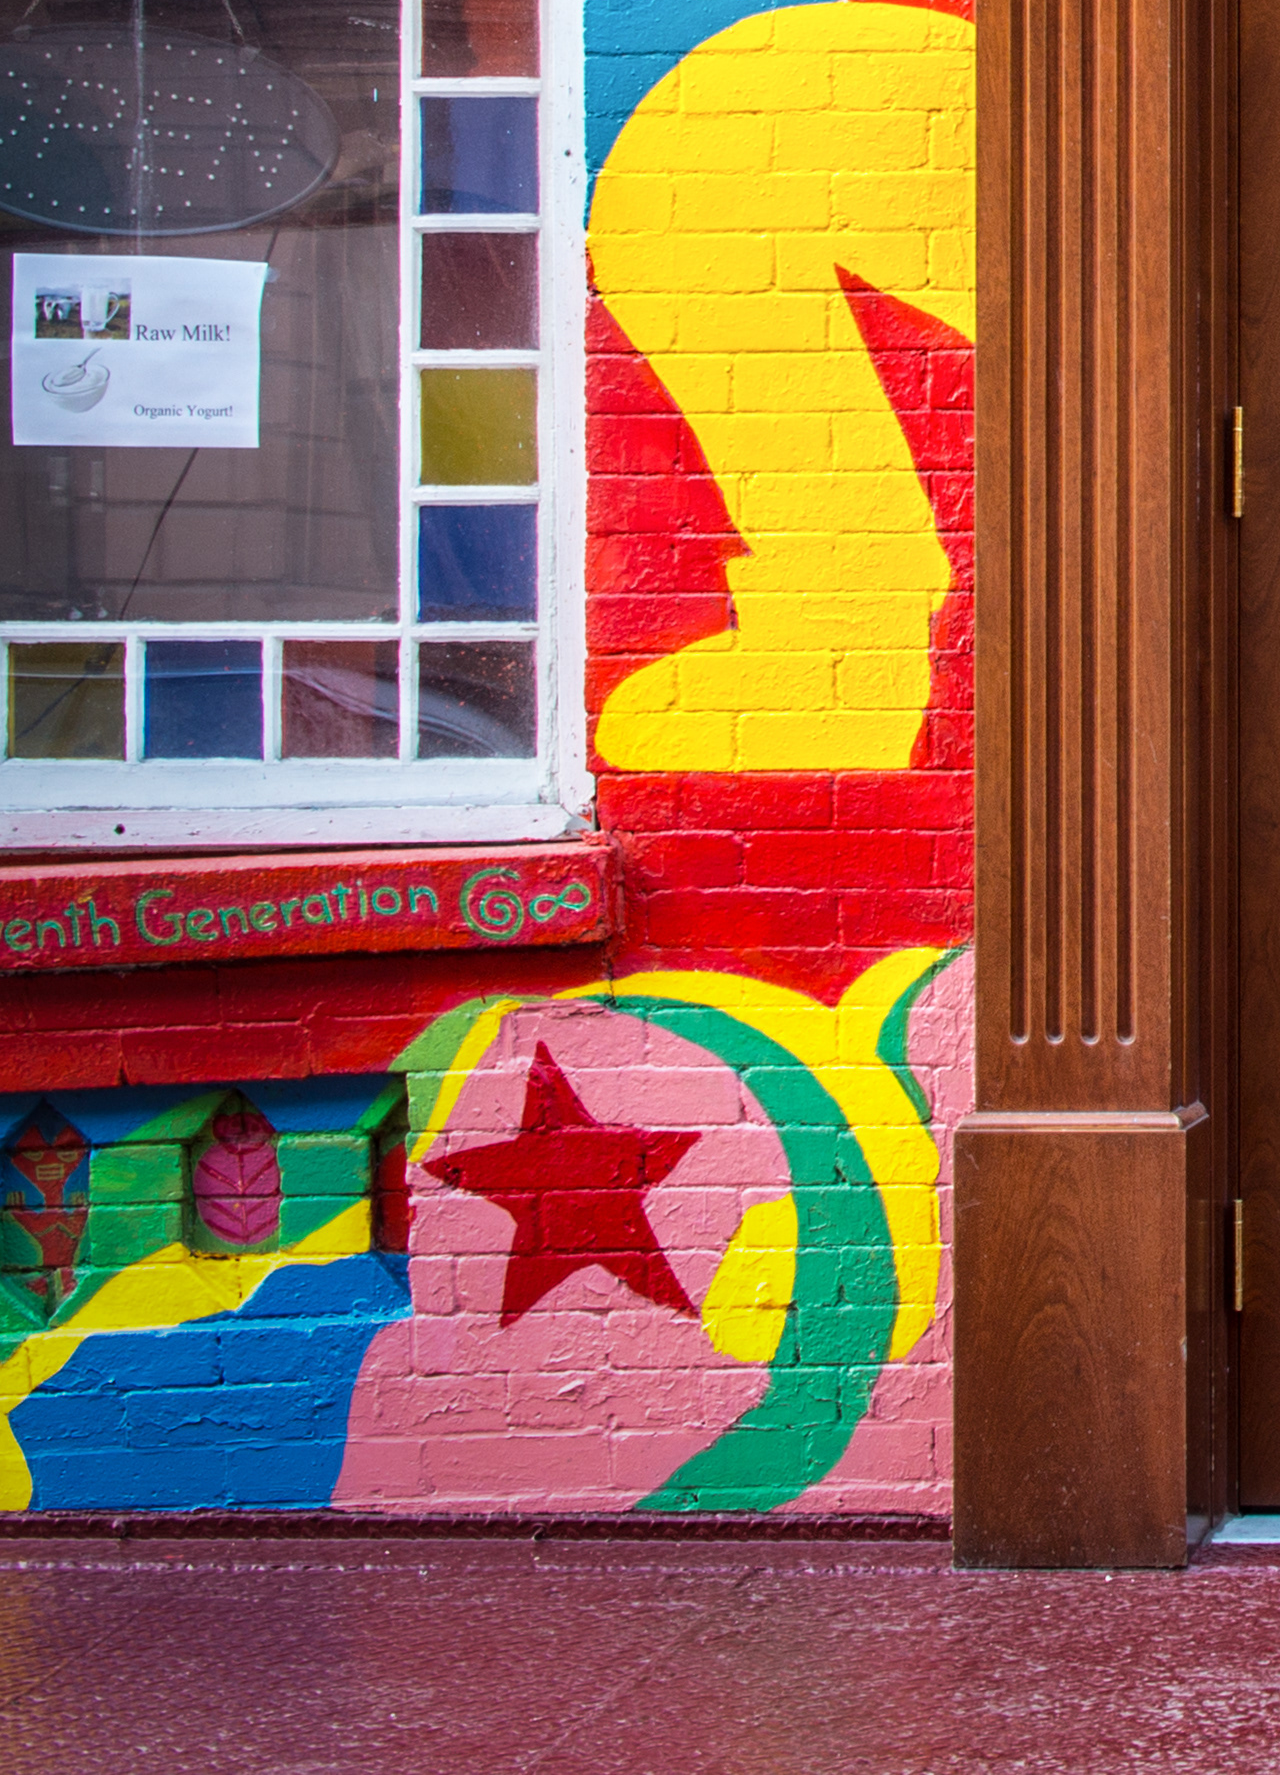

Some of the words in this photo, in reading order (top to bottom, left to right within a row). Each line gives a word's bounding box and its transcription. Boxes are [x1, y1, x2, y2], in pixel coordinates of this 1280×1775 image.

[135, 324, 176, 342] Raw
[182, 323, 232, 342] Milk!
[133, 404, 183, 421] Organic
[187, 404, 234, 421] Yogurt!
[0, 901, 121, 952] enth
[136, 879, 438, 946] Generation
